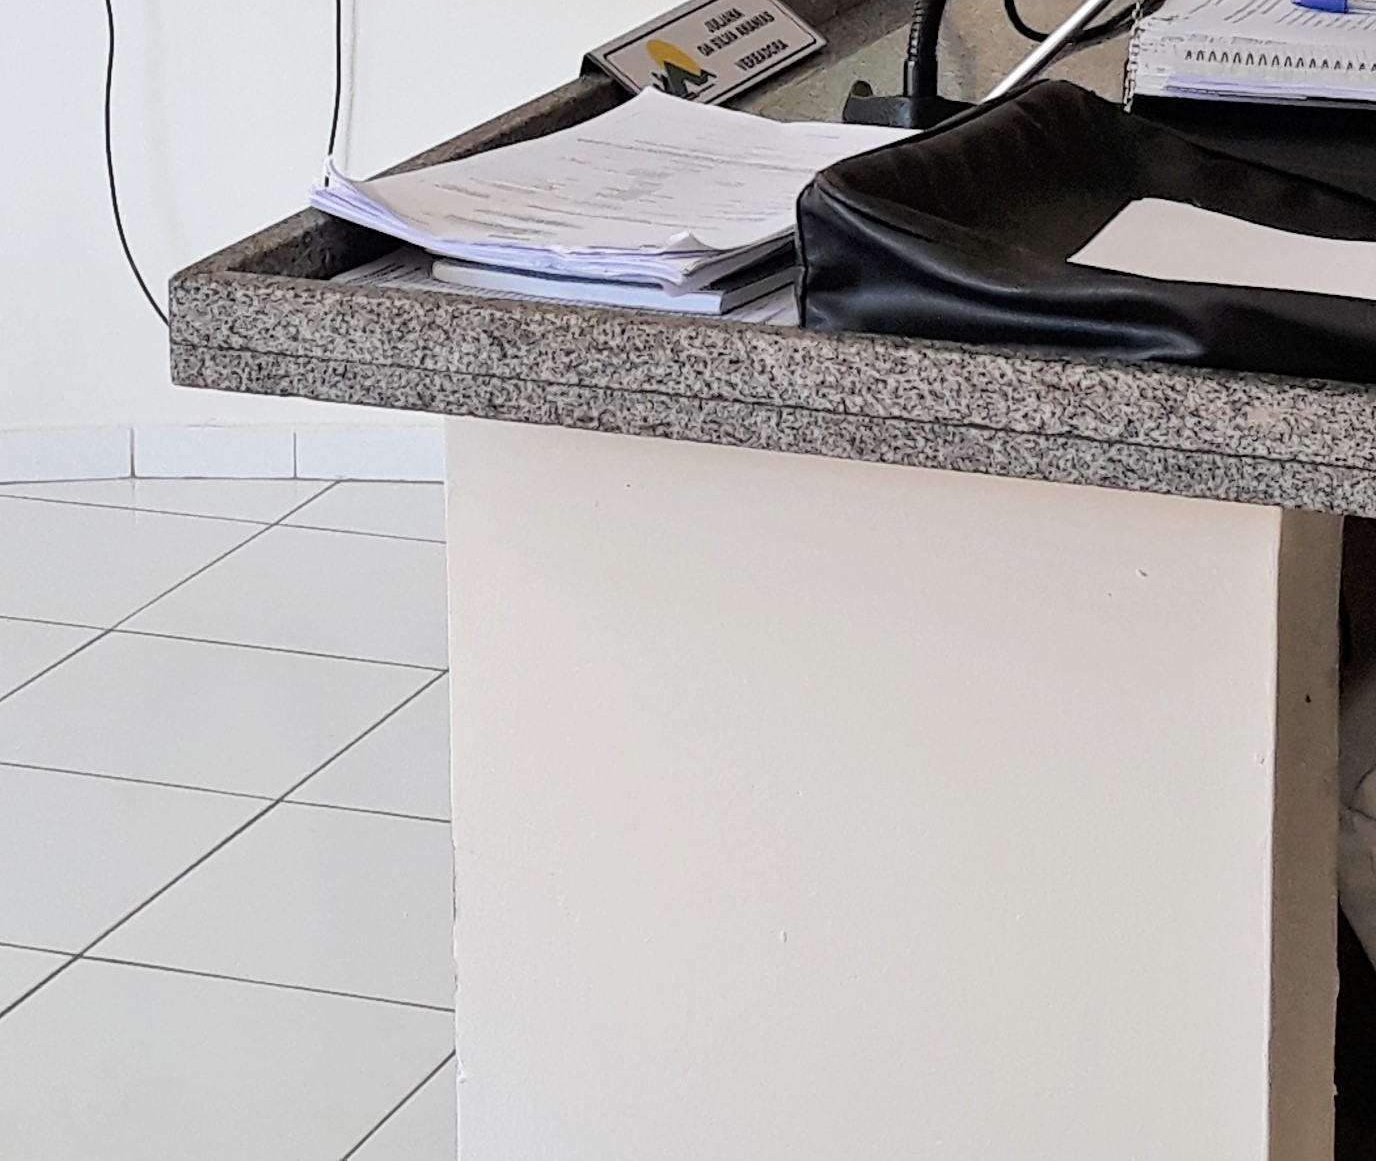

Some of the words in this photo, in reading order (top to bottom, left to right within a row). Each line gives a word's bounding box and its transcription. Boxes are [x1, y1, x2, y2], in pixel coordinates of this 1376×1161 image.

[696, 42, 715, 57] DA
[709, 30, 739, 50] SILVA
[734, 38, 790, 72] VEREADORA
